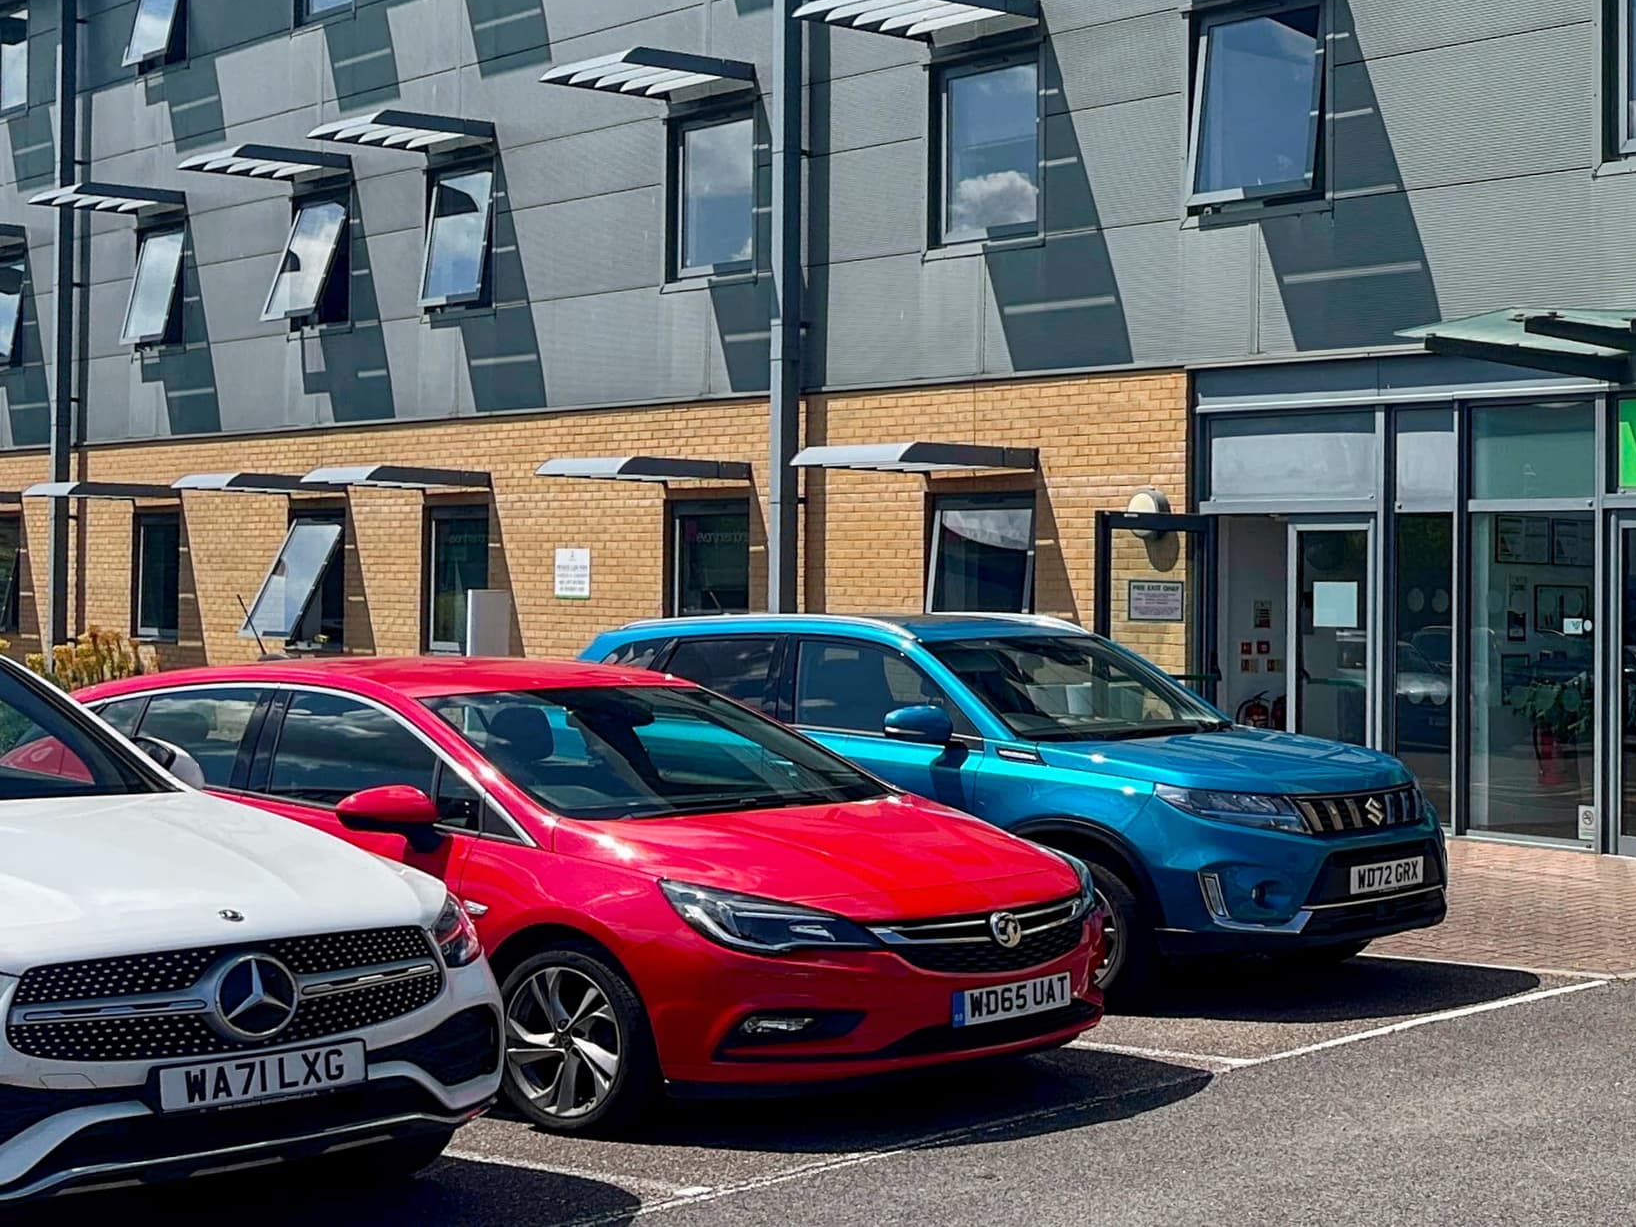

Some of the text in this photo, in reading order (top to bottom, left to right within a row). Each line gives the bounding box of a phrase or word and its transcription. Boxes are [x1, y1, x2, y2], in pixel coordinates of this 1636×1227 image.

[1357, 859, 1419, 890] WD72 GRX
[970, 974, 1068, 1018] WD65 UAT
[184, 1059, 268, 1103] WA71
[278, 1048, 345, 1089] LXG
